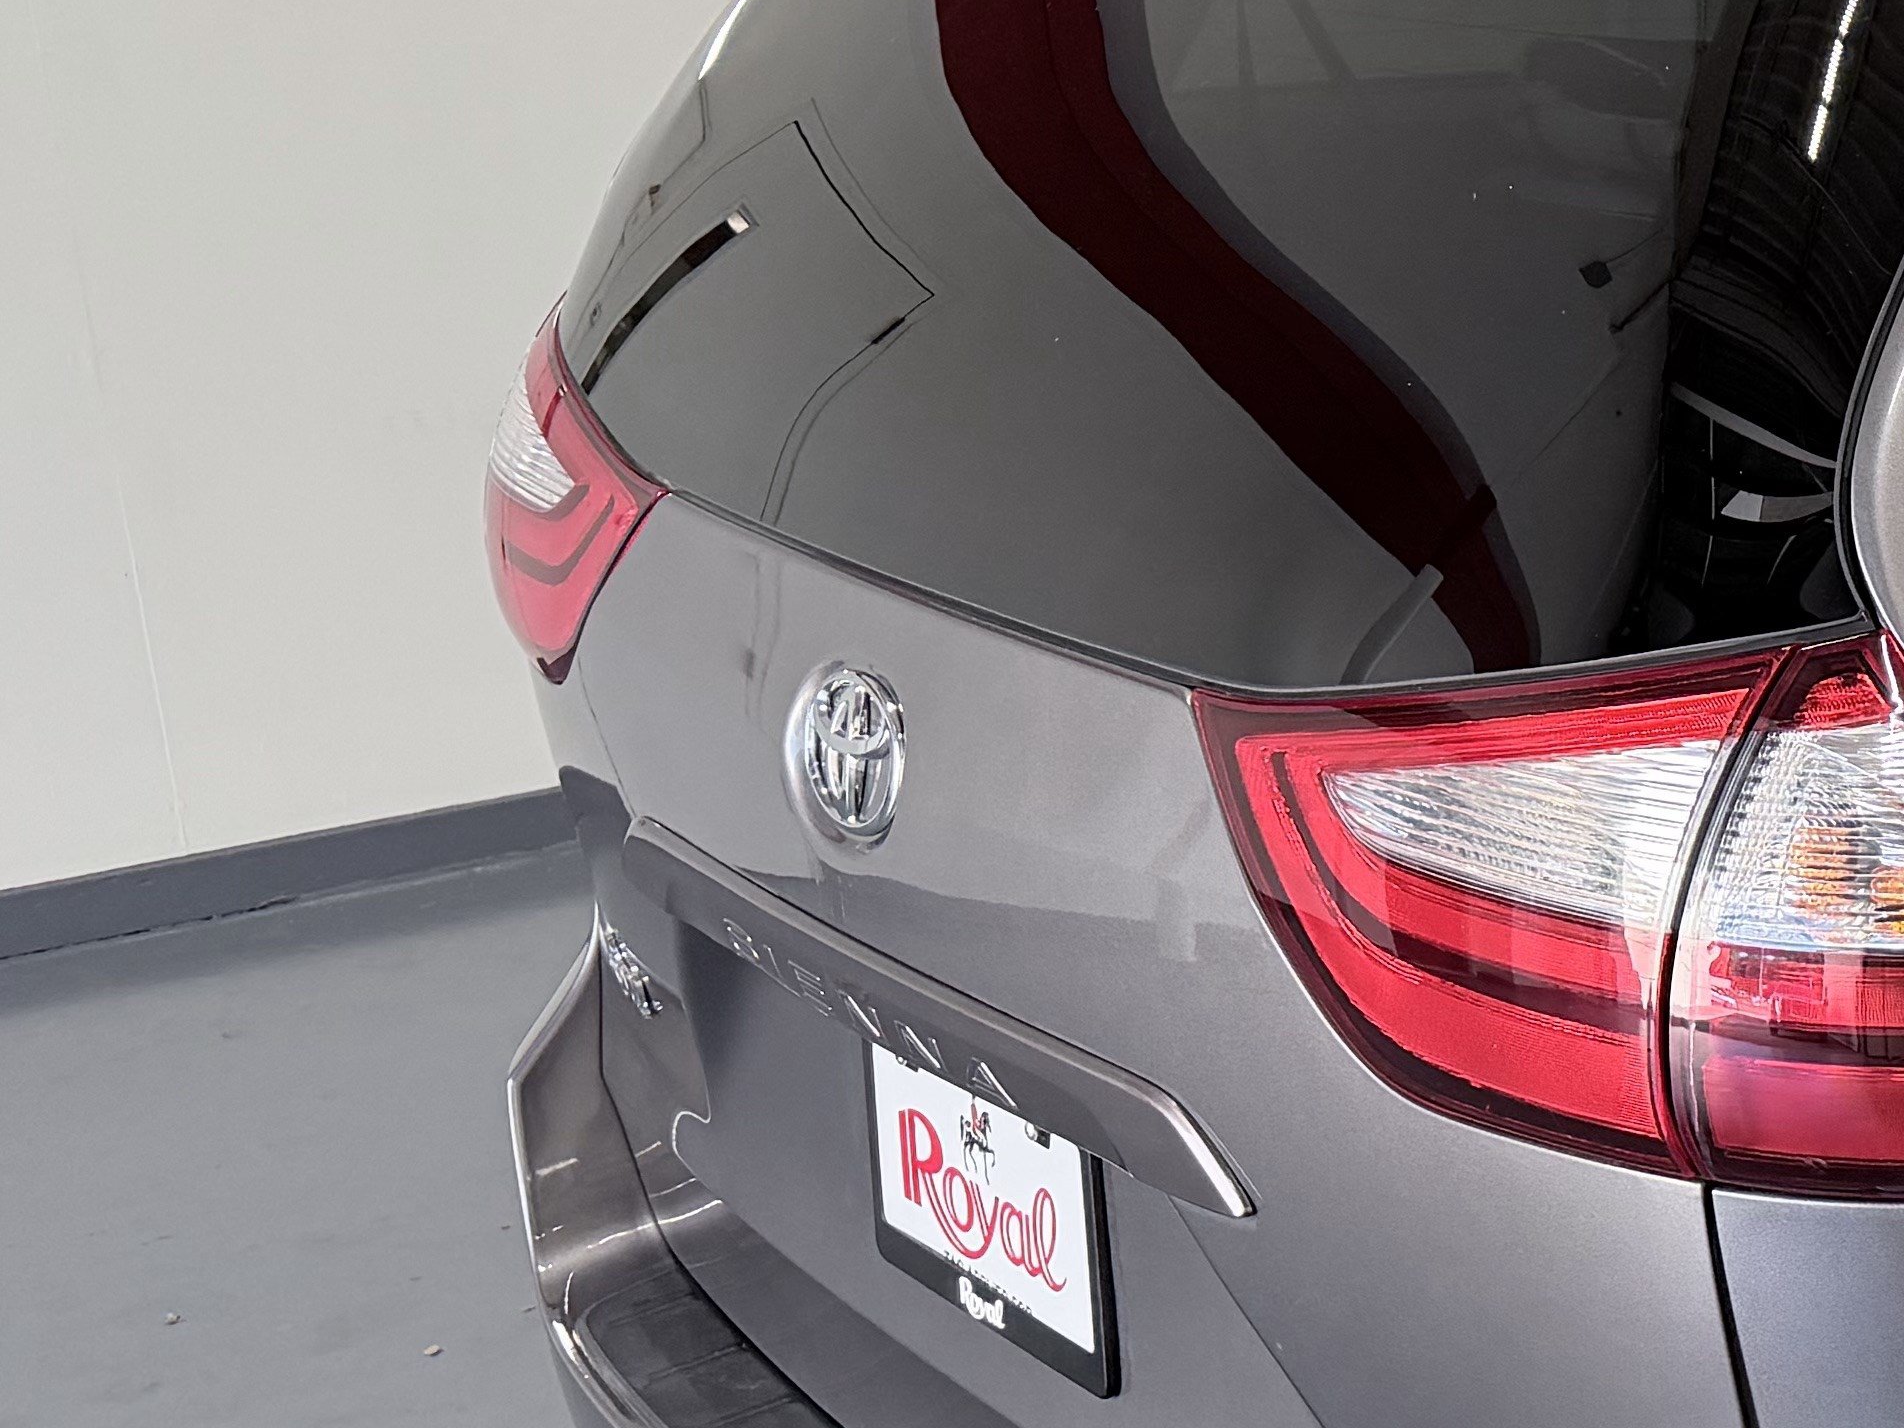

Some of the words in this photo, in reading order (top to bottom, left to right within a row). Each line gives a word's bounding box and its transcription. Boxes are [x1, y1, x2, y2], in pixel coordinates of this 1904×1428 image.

[722, 917, 1019, 1109] SIENNA
[898, 1107, 1068, 1292] Royal
[957, 1274, 1006, 1330] Royal
